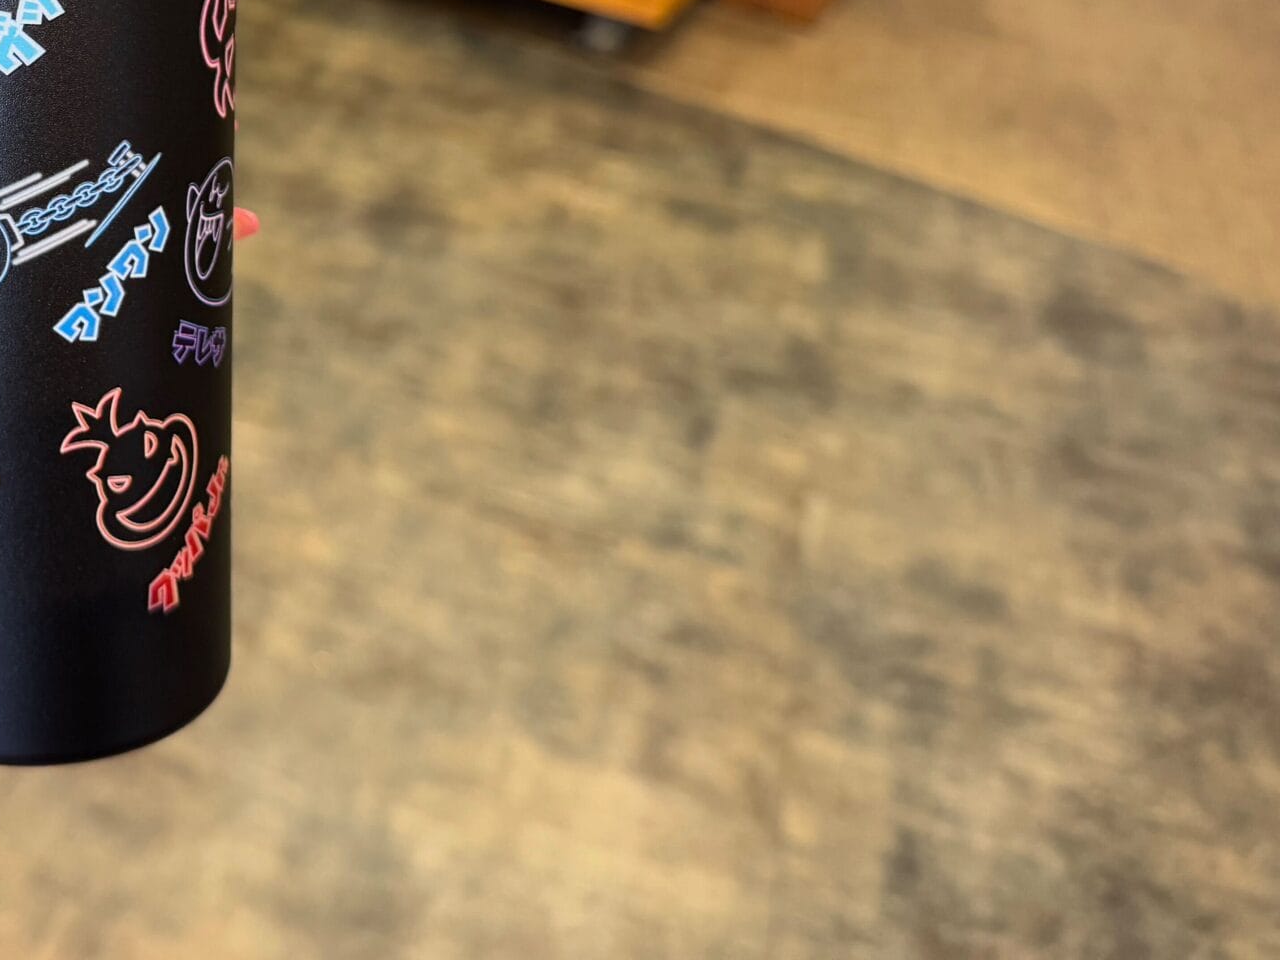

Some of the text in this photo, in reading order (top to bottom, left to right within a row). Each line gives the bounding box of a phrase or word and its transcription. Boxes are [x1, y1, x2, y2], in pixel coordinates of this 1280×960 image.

[53, 205, 170, 343] ワンワン
[172, 319, 227, 368] テレサ
